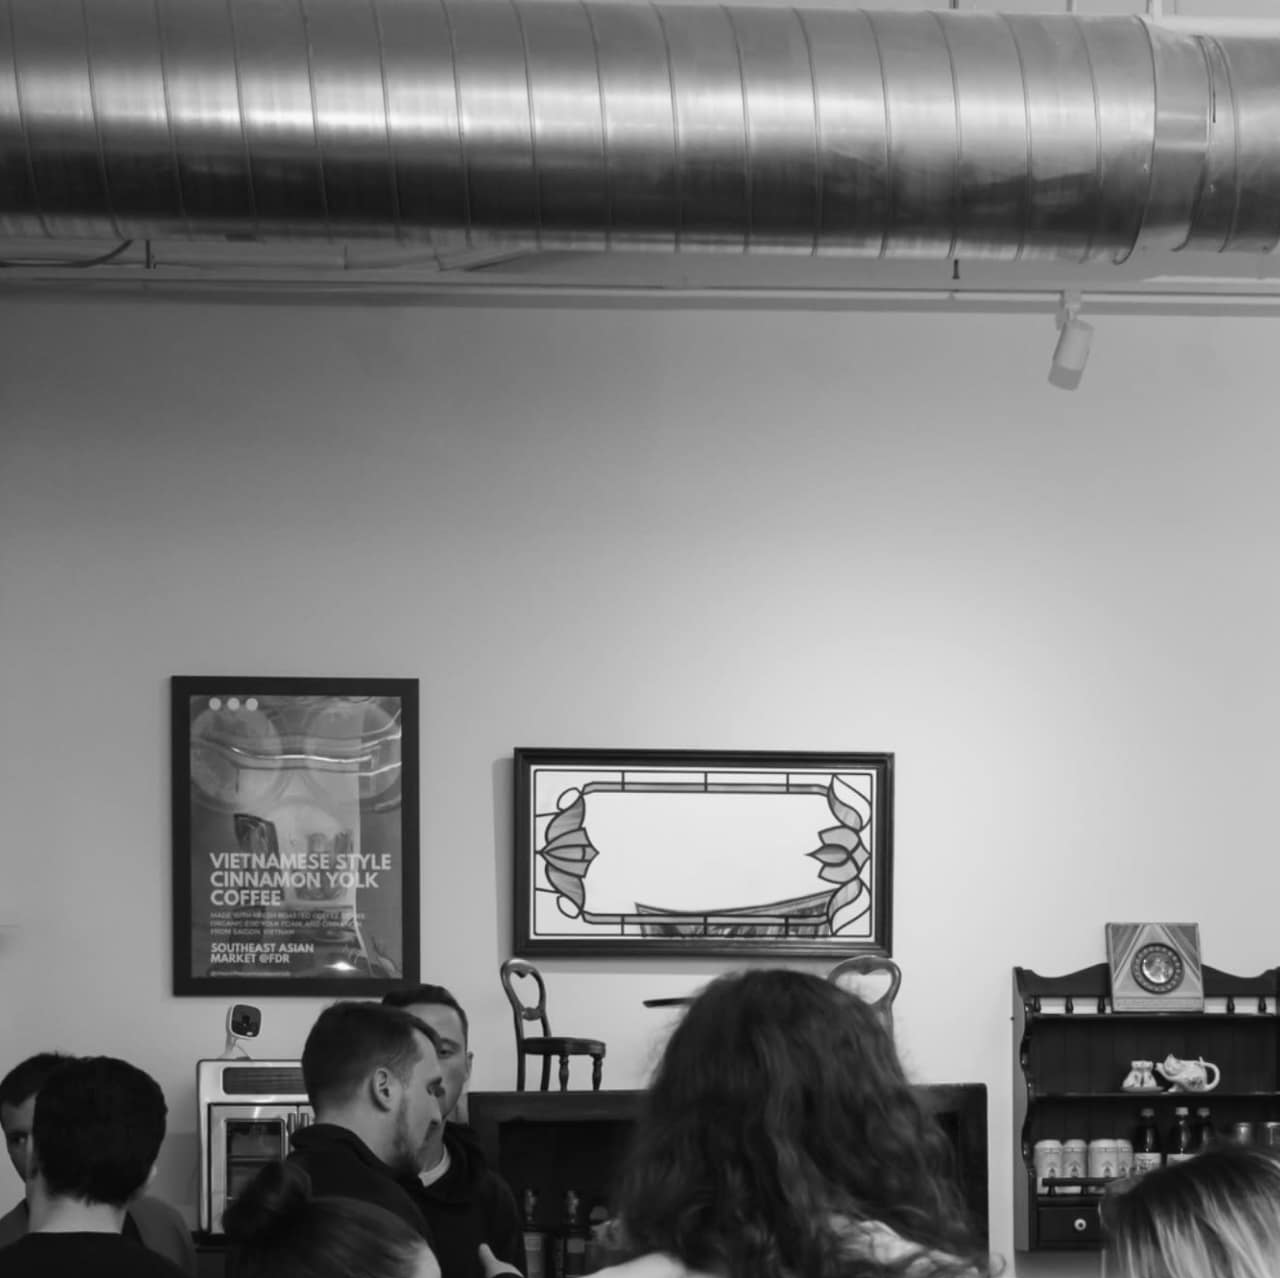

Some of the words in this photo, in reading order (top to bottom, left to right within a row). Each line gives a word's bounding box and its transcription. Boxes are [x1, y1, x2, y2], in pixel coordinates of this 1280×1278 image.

[209, 852, 330, 870] VIETNAMESE
[335, 853, 392, 871] STYLE
[209, 871, 320, 888] CINNAMON
[326, 872, 379, 888] YOLK
[210, 889, 281, 906] COFFEE
[210, 943, 276, 953] SOUTHEAST
[279, 943, 314, 953] ASIAN
[210, 953, 256, 963] MARKET
[259, 953, 290, 964] @FDR
